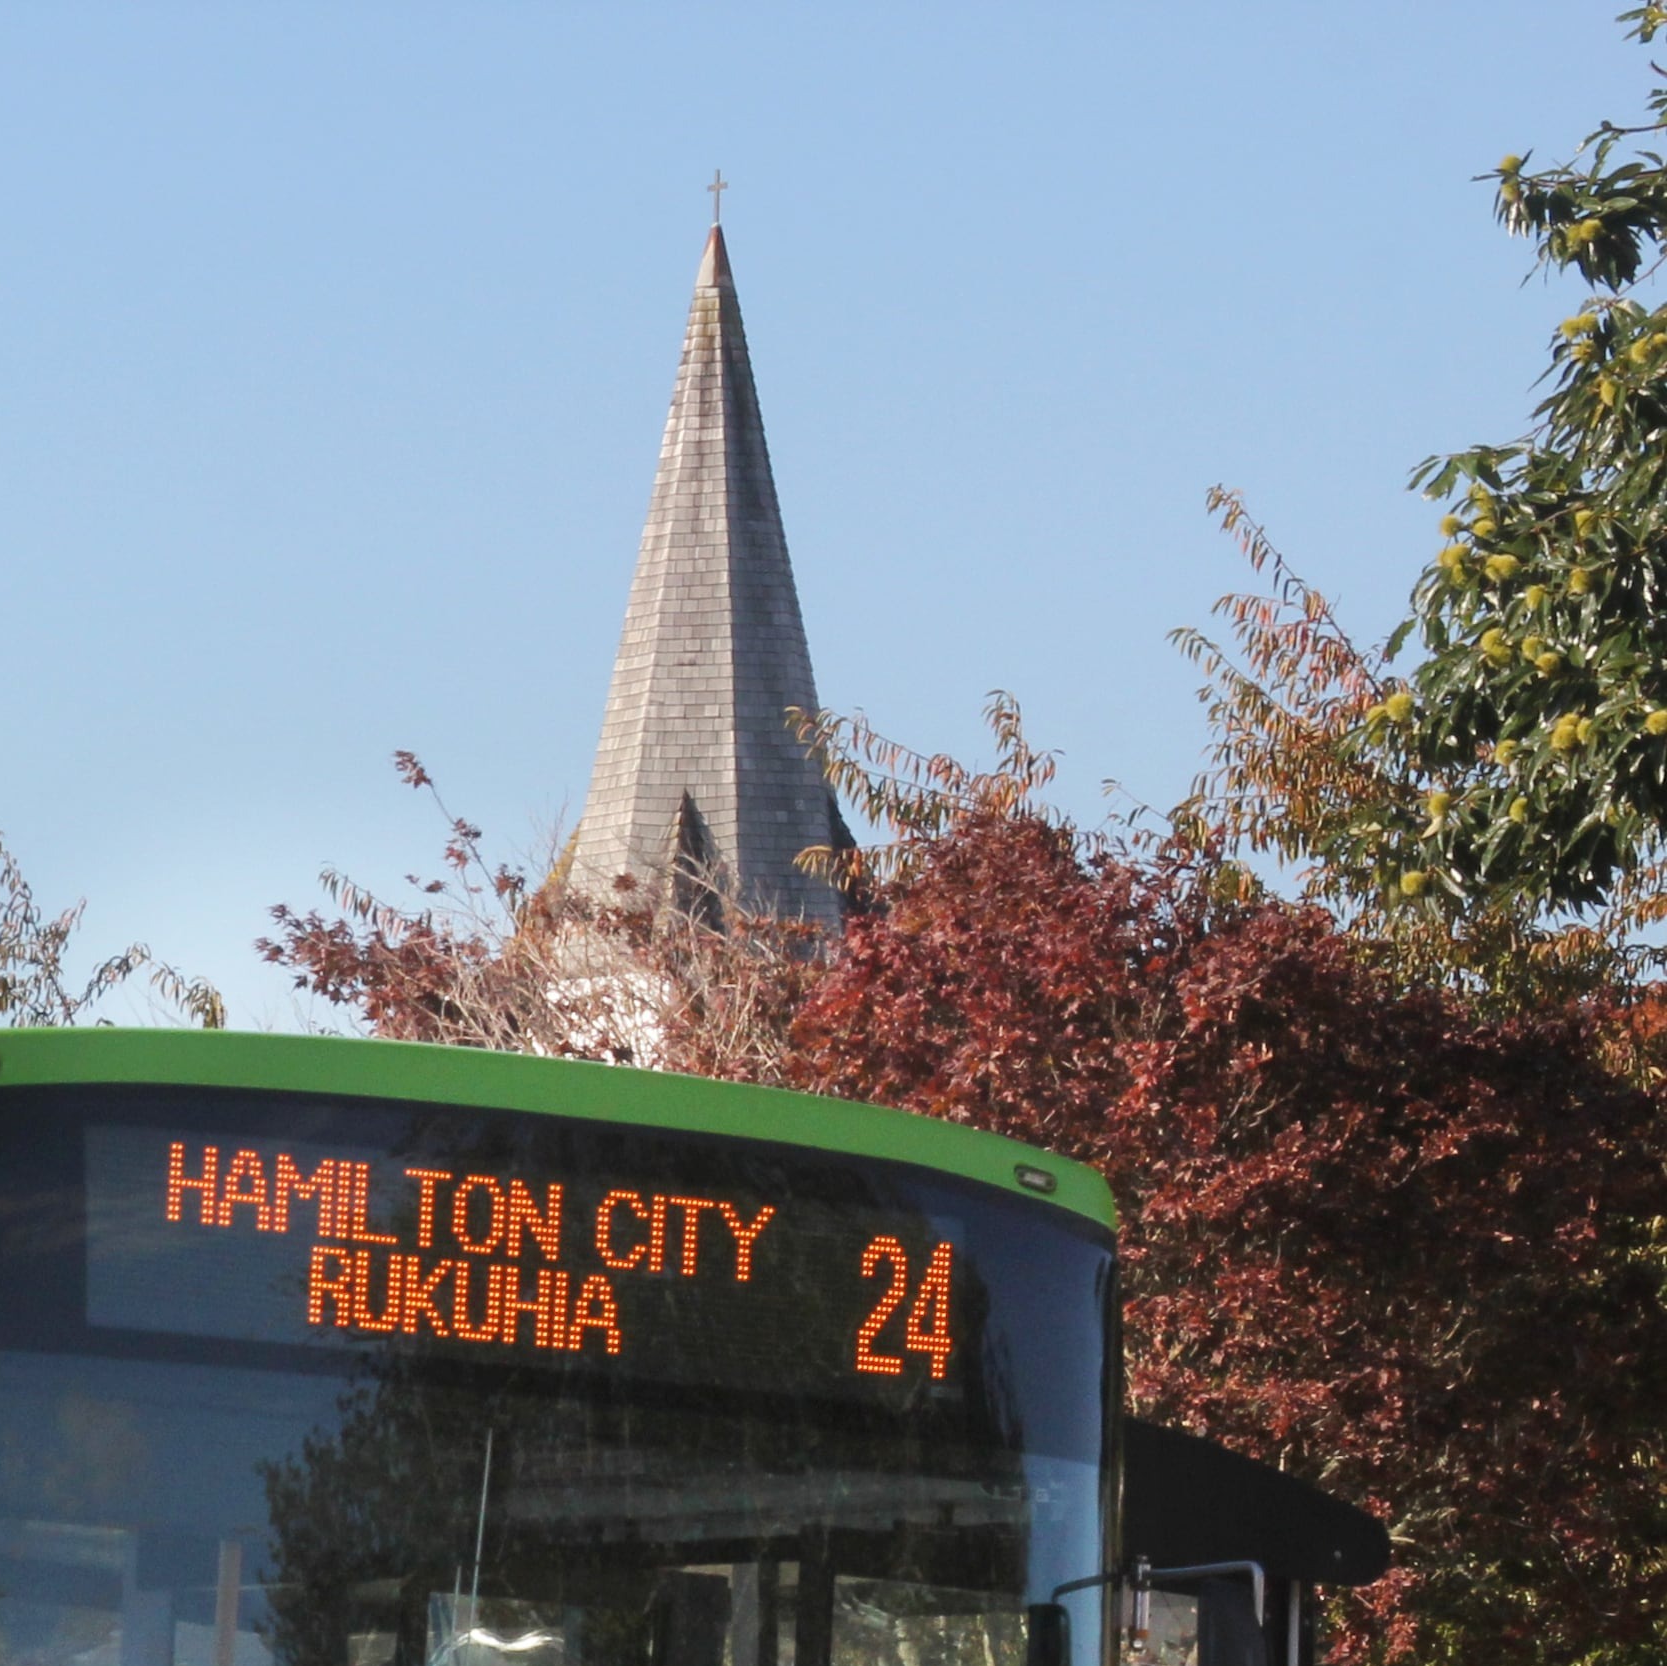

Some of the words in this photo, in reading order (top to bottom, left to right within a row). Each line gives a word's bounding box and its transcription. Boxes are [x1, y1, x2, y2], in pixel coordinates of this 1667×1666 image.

[164, 1142, 561, 1261] HAMILTON
[595, 1187, 775, 1282] CITY
[307, 1246, 622, 1354] RUKUHIA
[854, 1234, 953, 1380] 24
